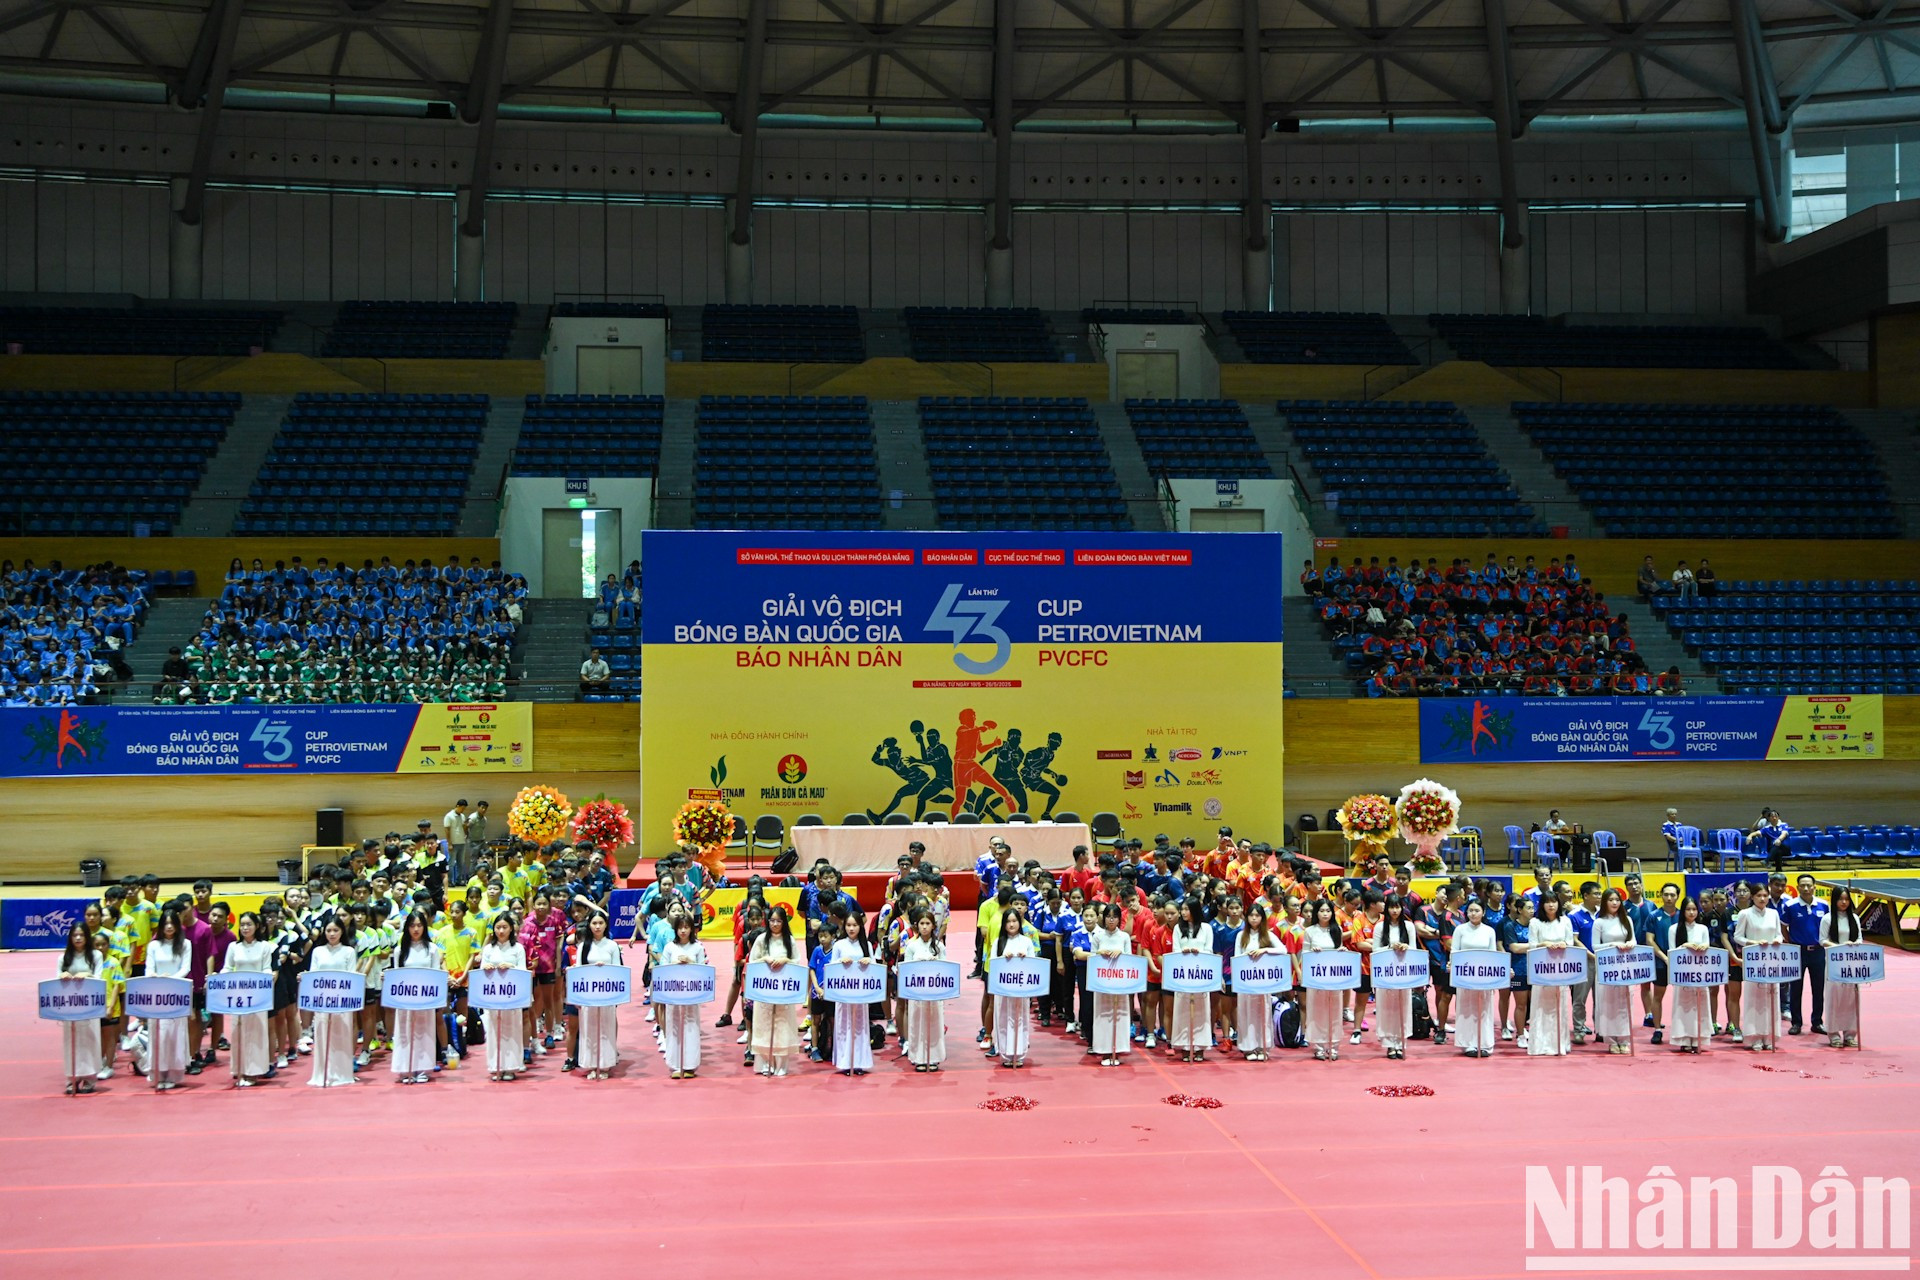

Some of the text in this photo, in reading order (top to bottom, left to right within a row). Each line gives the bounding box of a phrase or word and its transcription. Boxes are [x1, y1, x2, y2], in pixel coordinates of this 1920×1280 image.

[567, 482, 587, 490] KHU B
[831, 554, 845, 562] LỊCH
[846, 553, 867, 561] THÀNH
[868, 552, 882, 561] PHỐ
[882, 553, 891, 561] ĐÀ
[892, 552, 910, 561] NẴNG
[1077, 554, 1094, 562] LIÊN
[1095, 553, 1115, 562] ĐOÀN
[1117, 553, 1137, 561] BÓNG
[1154, 554, 1170, 562] VIỆT
[968, 588, 999, 596] LẦN THỨ
[762, 593, 902, 621] GIẢI VÔ ĐỊCH
[1038, 600, 1082, 617] CUP
[674, 617, 903, 643] BÓNG BÀN QUỐC GIA
[923, 583, 1011, 675] 43
[1038, 625, 1202, 642] PETROVIETNAM
[736, 645, 902, 667] BÁO NHÂN DÂN
[1038, 650, 1108, 667] PVCFC
[1146, 728, 1197, 736] NHÀ TÀI TRỢ
[1637, 708, 1675, 750] 43
[1686, 721, 1706, 730] CUP
[169, 729, 239, 743] GIẢI VÔ ĐỊCH
[249, 718, 293, 762] 43
[305, 731, 328, 740] CUP
[710, 730, 809, 740] NHÀ ĐỒNG HÀNH CHÍNH
[1686, 731, 1758, 740] PETROVIETNAM
[126, 740, 239, 754] BÓNG BÀN QUỐC GIA
[305, 743, 388, 752] PETROVIETNAM
[1686, 743, 1717, 752] PVCFC
[156, 754, 239, 766] BÁO NHÂN DÂN
[305, 755, 341, 764] PVCFC
[761, 786, 825, 799] PHÂN BÓN CÀ MAU
[1153, 802, 1192, 812] Vinamilk
[1865, 903, 1884, 929] SPORT
[1676, 953, 1721, 967] CÂU LẠC BỘ
[1746, 951, 1799, 962] CLB P. 14, Q. 10
[1830, 951, 1880, 961] CLB TRÀNG AN
[1096, 967, 1139, 981] TRỌNG TÀI
[1173, 965, 1213, 980] ĐÀ NẴNG
[1240, 966, 1283, 982] QUÂN ĐỘI
[1310, 963, 1352, 977] TÂY NINH
[1373, 963, 1427, 978] TP. HỒ CHÍ MINH
[1455, 962, 1506, 977] TIẾN GIANG
[1534, 961, 1582, 974] VĨNH LONG
[1603, 967, 1651, 982] PPP CÀ MAU
[1746, 963, 1799, 978] TP. HỒ CHÍ MINH
[1841, 965, 1870, 980] HÀ NỘI
[208, 979, 272, 990] CÔNG AN NHÂN DÂN
[313, 977, 351, 990] CÔNG AN
[652, 976, 714, 991] HẢI DƯƠNG-LONG HẢI
[752, 977, 800, 991] HƯNG YÊN
[827, 975, 882, 990] KHÁNH HÒA
[905, 972, 954, 988] LÂM ĐỒNG
[999, 971, 1040, 987] NGHỆ AN
[1674, 972, 1725, 983] TIMES CITY
[390, 981, 439, 997] ĐỒNG NAI
[483, 981, 516, 998] HÀ NỘI
[572, 977, 625, 993] HẢI PHÒNG
[40, 992, 106, 1010] BÀ RỊA-VŨNG TÀU
[128, 991, 190, 1006] BÌNH DƯƠNG
[227, 996, 253, 1008] T & T
[300, 993, 362, 1009] TP. HỒ CHÍ MINH
